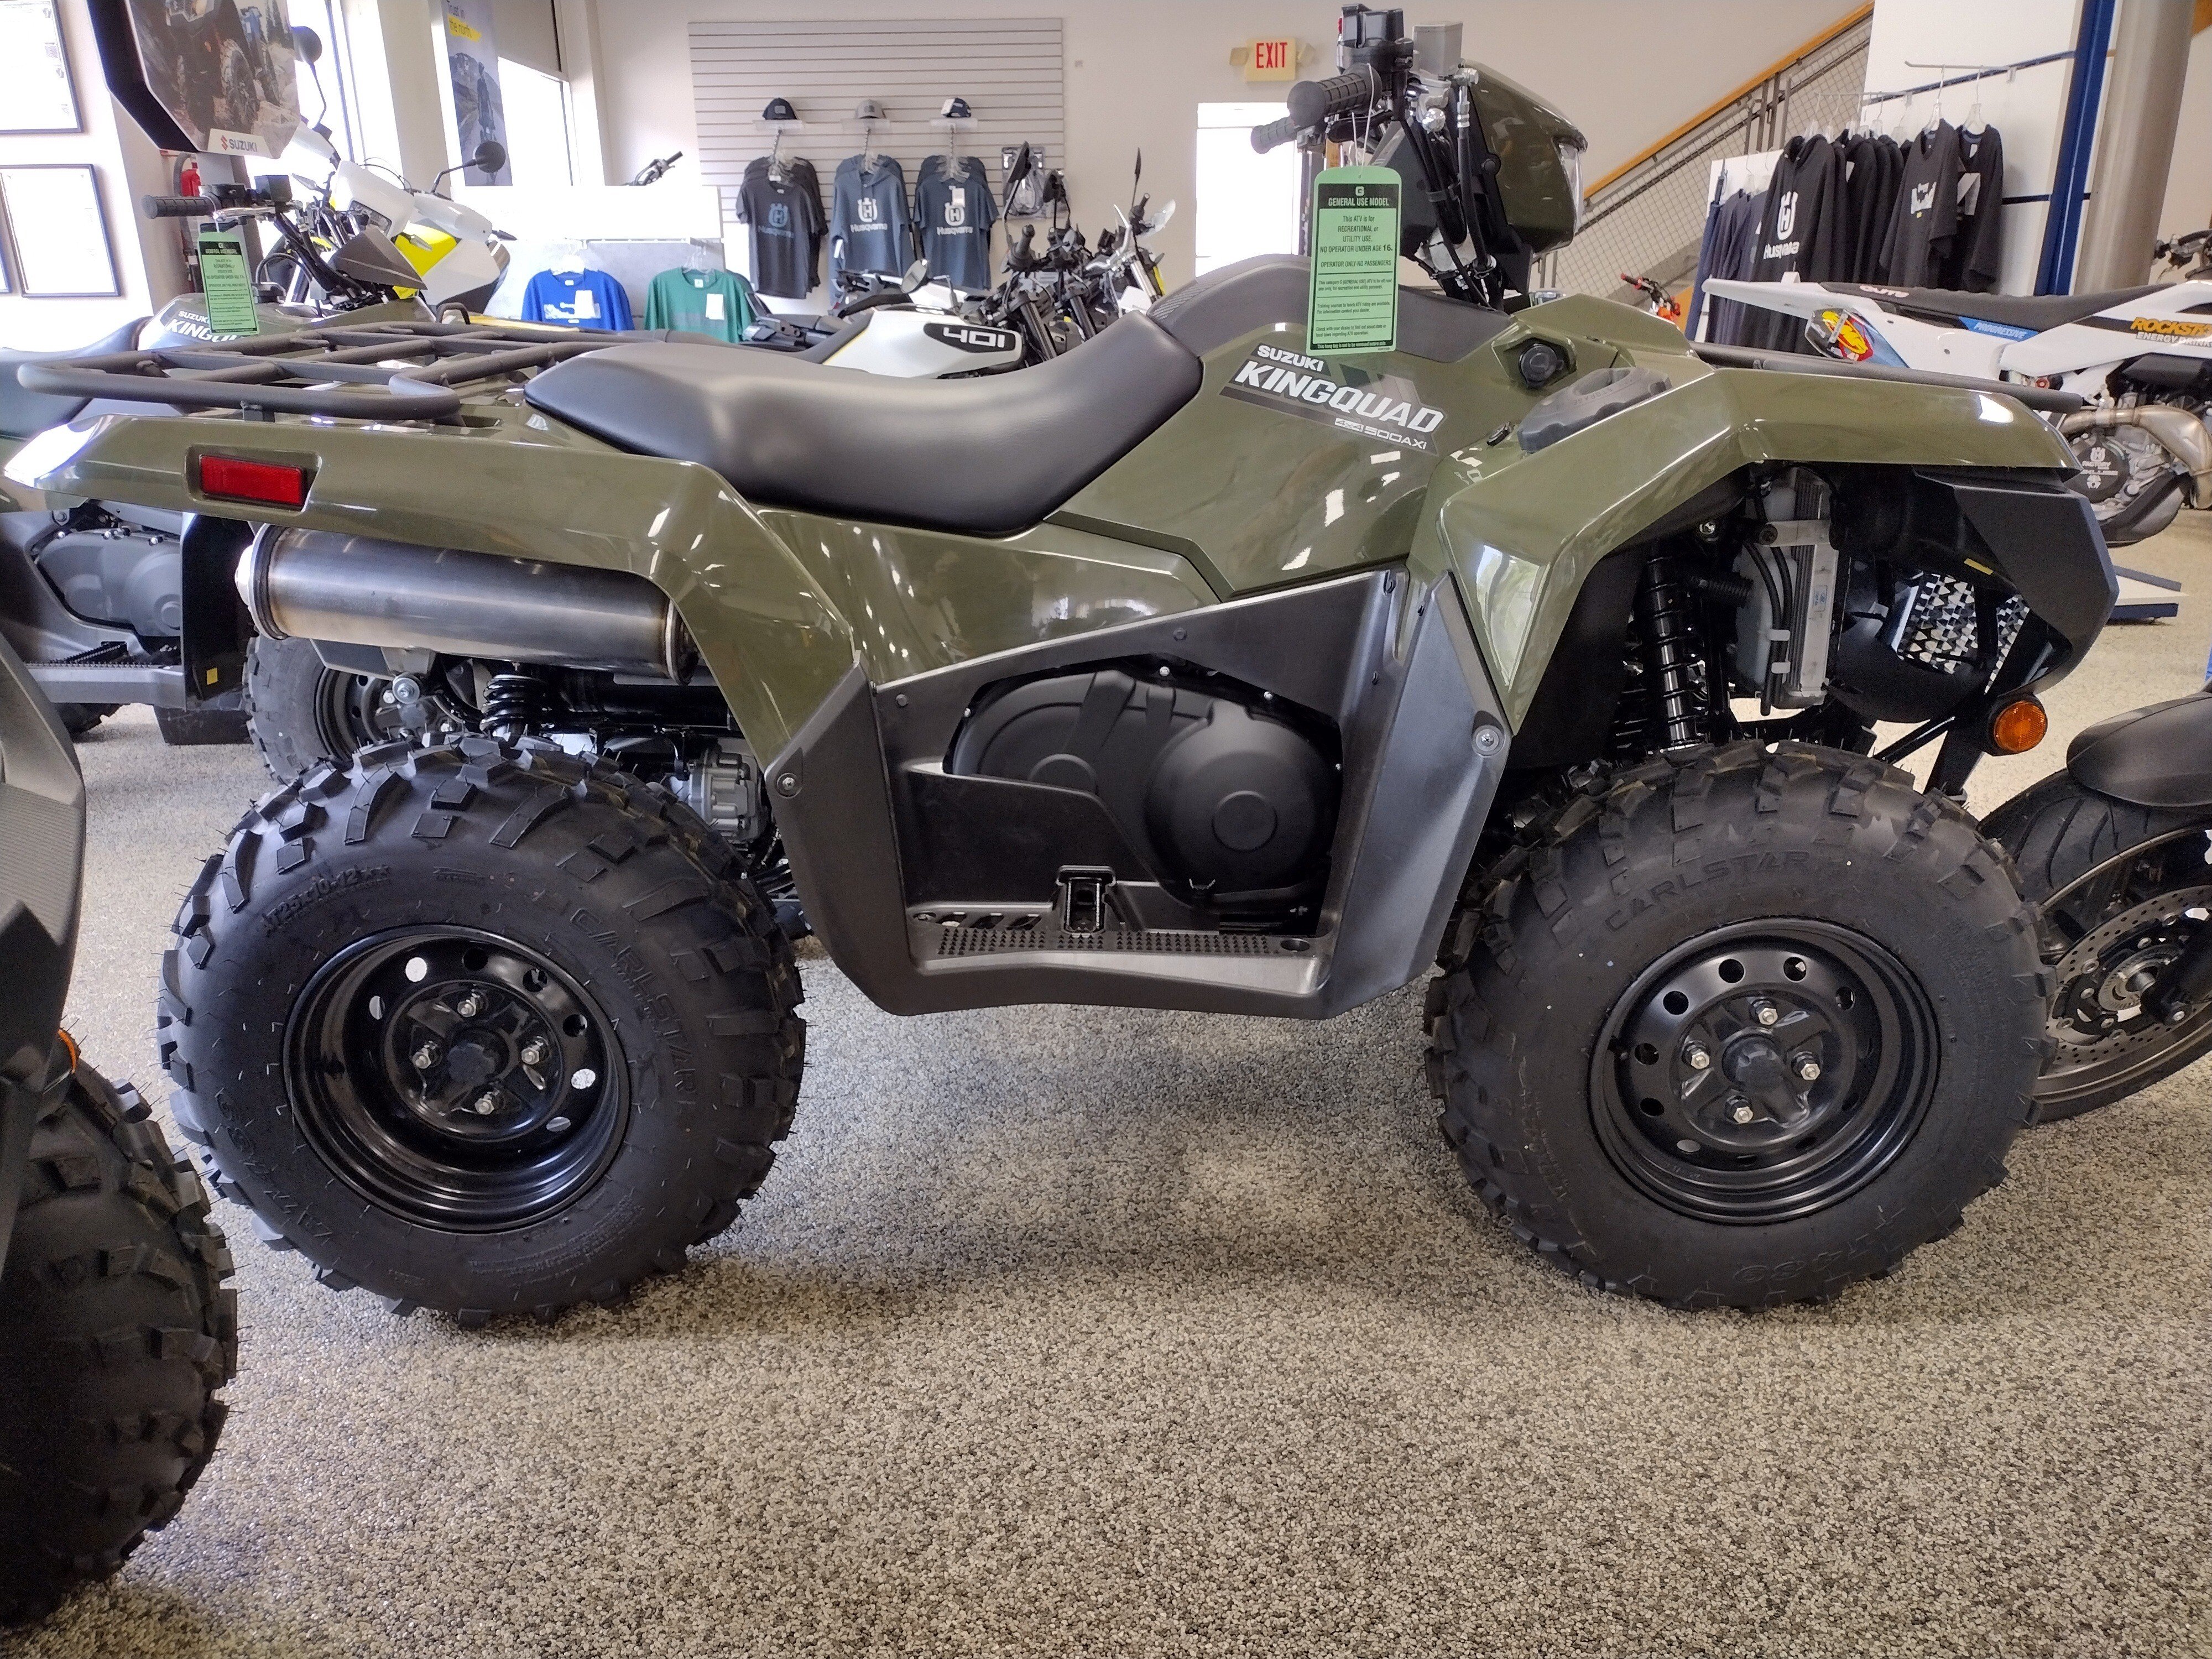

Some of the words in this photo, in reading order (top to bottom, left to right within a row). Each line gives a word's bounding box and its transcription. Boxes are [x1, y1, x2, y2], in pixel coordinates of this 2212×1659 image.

[1256, 42, 1287, 68] EXIT
[229, 139, 257, 152] SUZUKI
[1355, 186, 1364, 196] G
[850, 223, 888, 233] Husqvarna
[178, 311, 209, 324] SUZUK
[943, 327, 1005, 348] 401
[1973, 322, 2027, 339] PROGRESSIVE
[2136, 332, 2179, 343] ENERGY
[1257, 345, 1324, 372] SUZUKI
[1234, 361, 1444, 432] KINGQUAD
[1603, 851, 1809, 932] CARLSTAR
